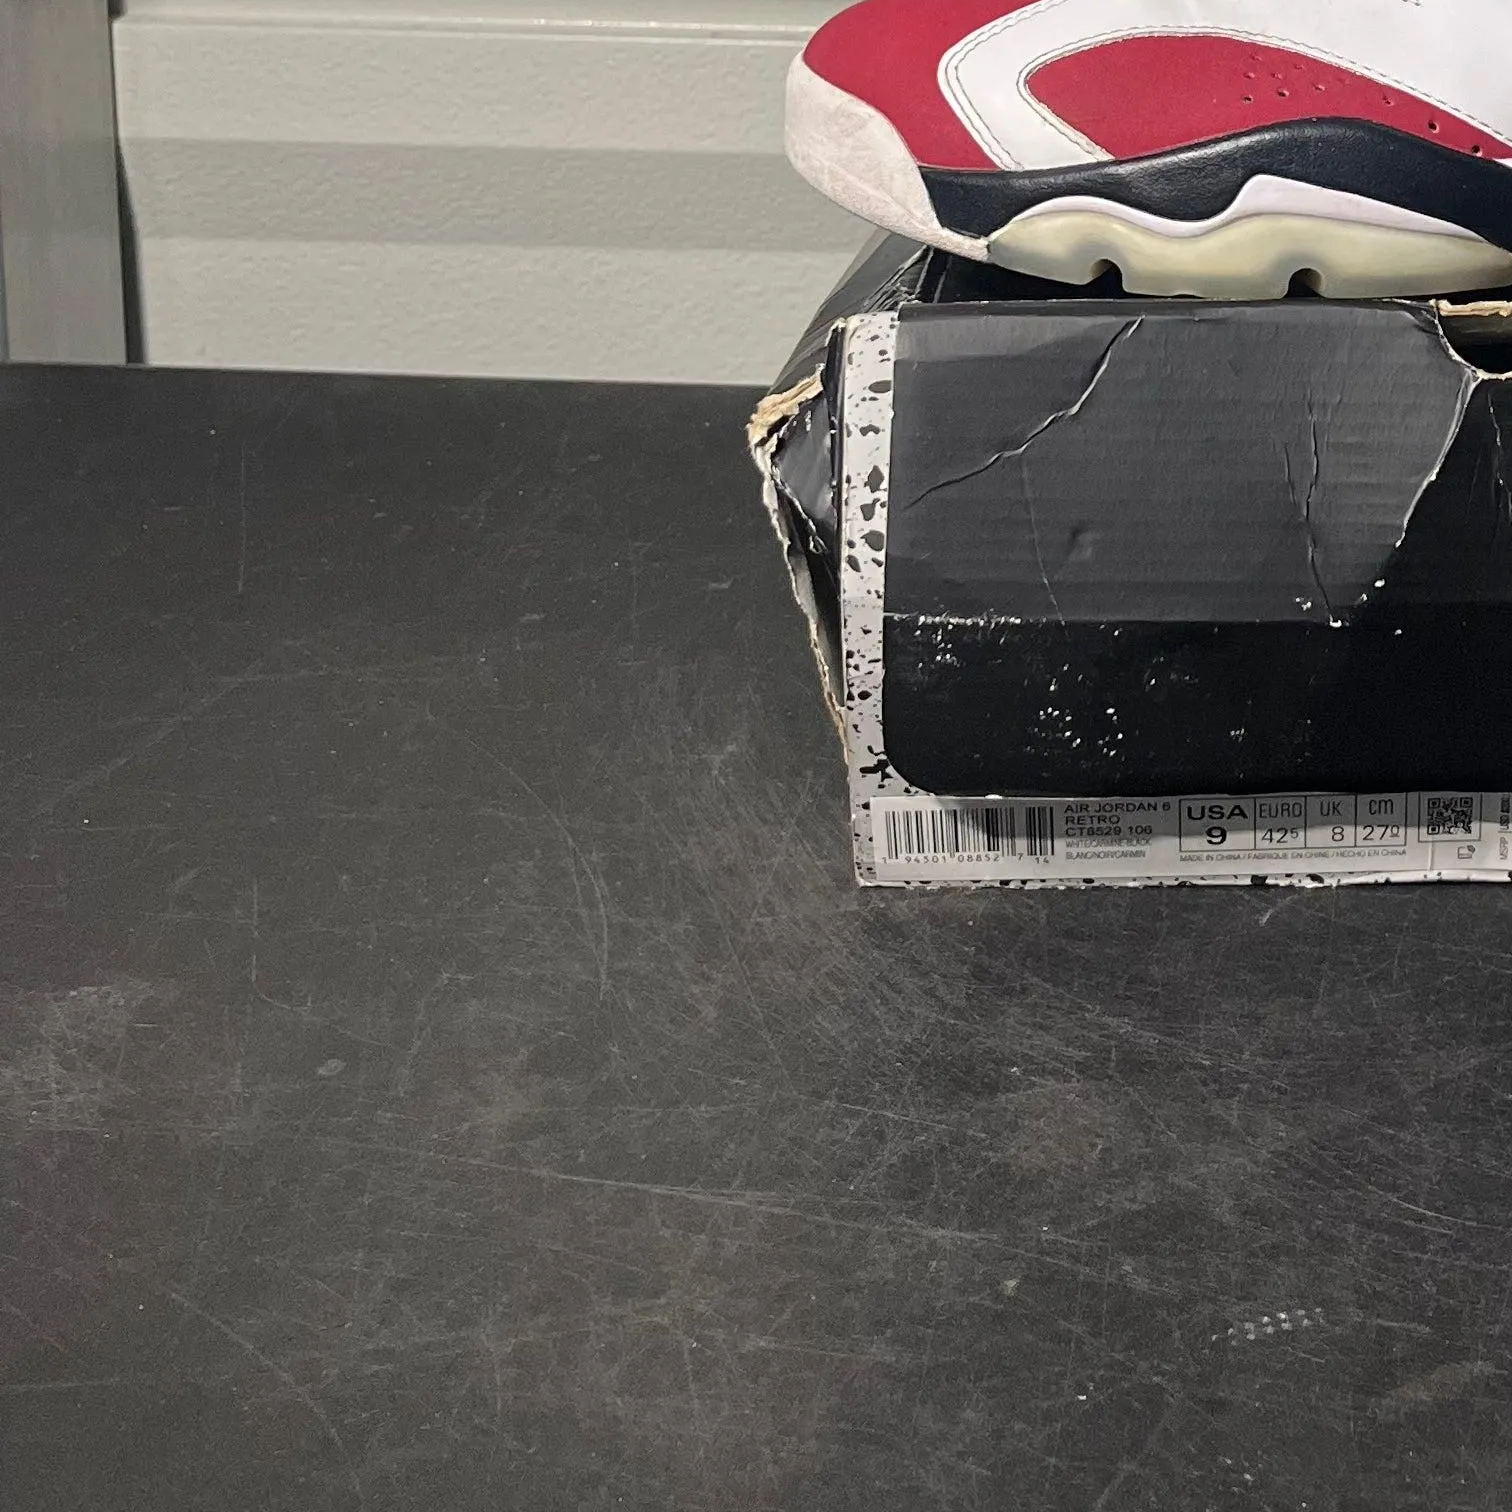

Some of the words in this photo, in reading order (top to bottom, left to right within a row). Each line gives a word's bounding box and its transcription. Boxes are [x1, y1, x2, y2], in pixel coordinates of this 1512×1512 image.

[1063, 803, 1090, 814] AIR
[1094, 801, 1158, 813] JORDAN
[1186, 804, 1249, 821] USA
[1259, 801, 1303, 819] EURO
[1319, 800, 1342, 817] UK
[1368, 797, 1394, 816] cm
[1065, 814, 1121, 826] RETRO
[1065, 825, 1122, 837] CT8529
[1128, 824, 1153, 835] 106
[1205, 825, 1227, 846] 9
[1331, 825, 1345, 842] 8
[904, 855, 947, 864] 94501
[957, 853, 1000, 863] 08852
